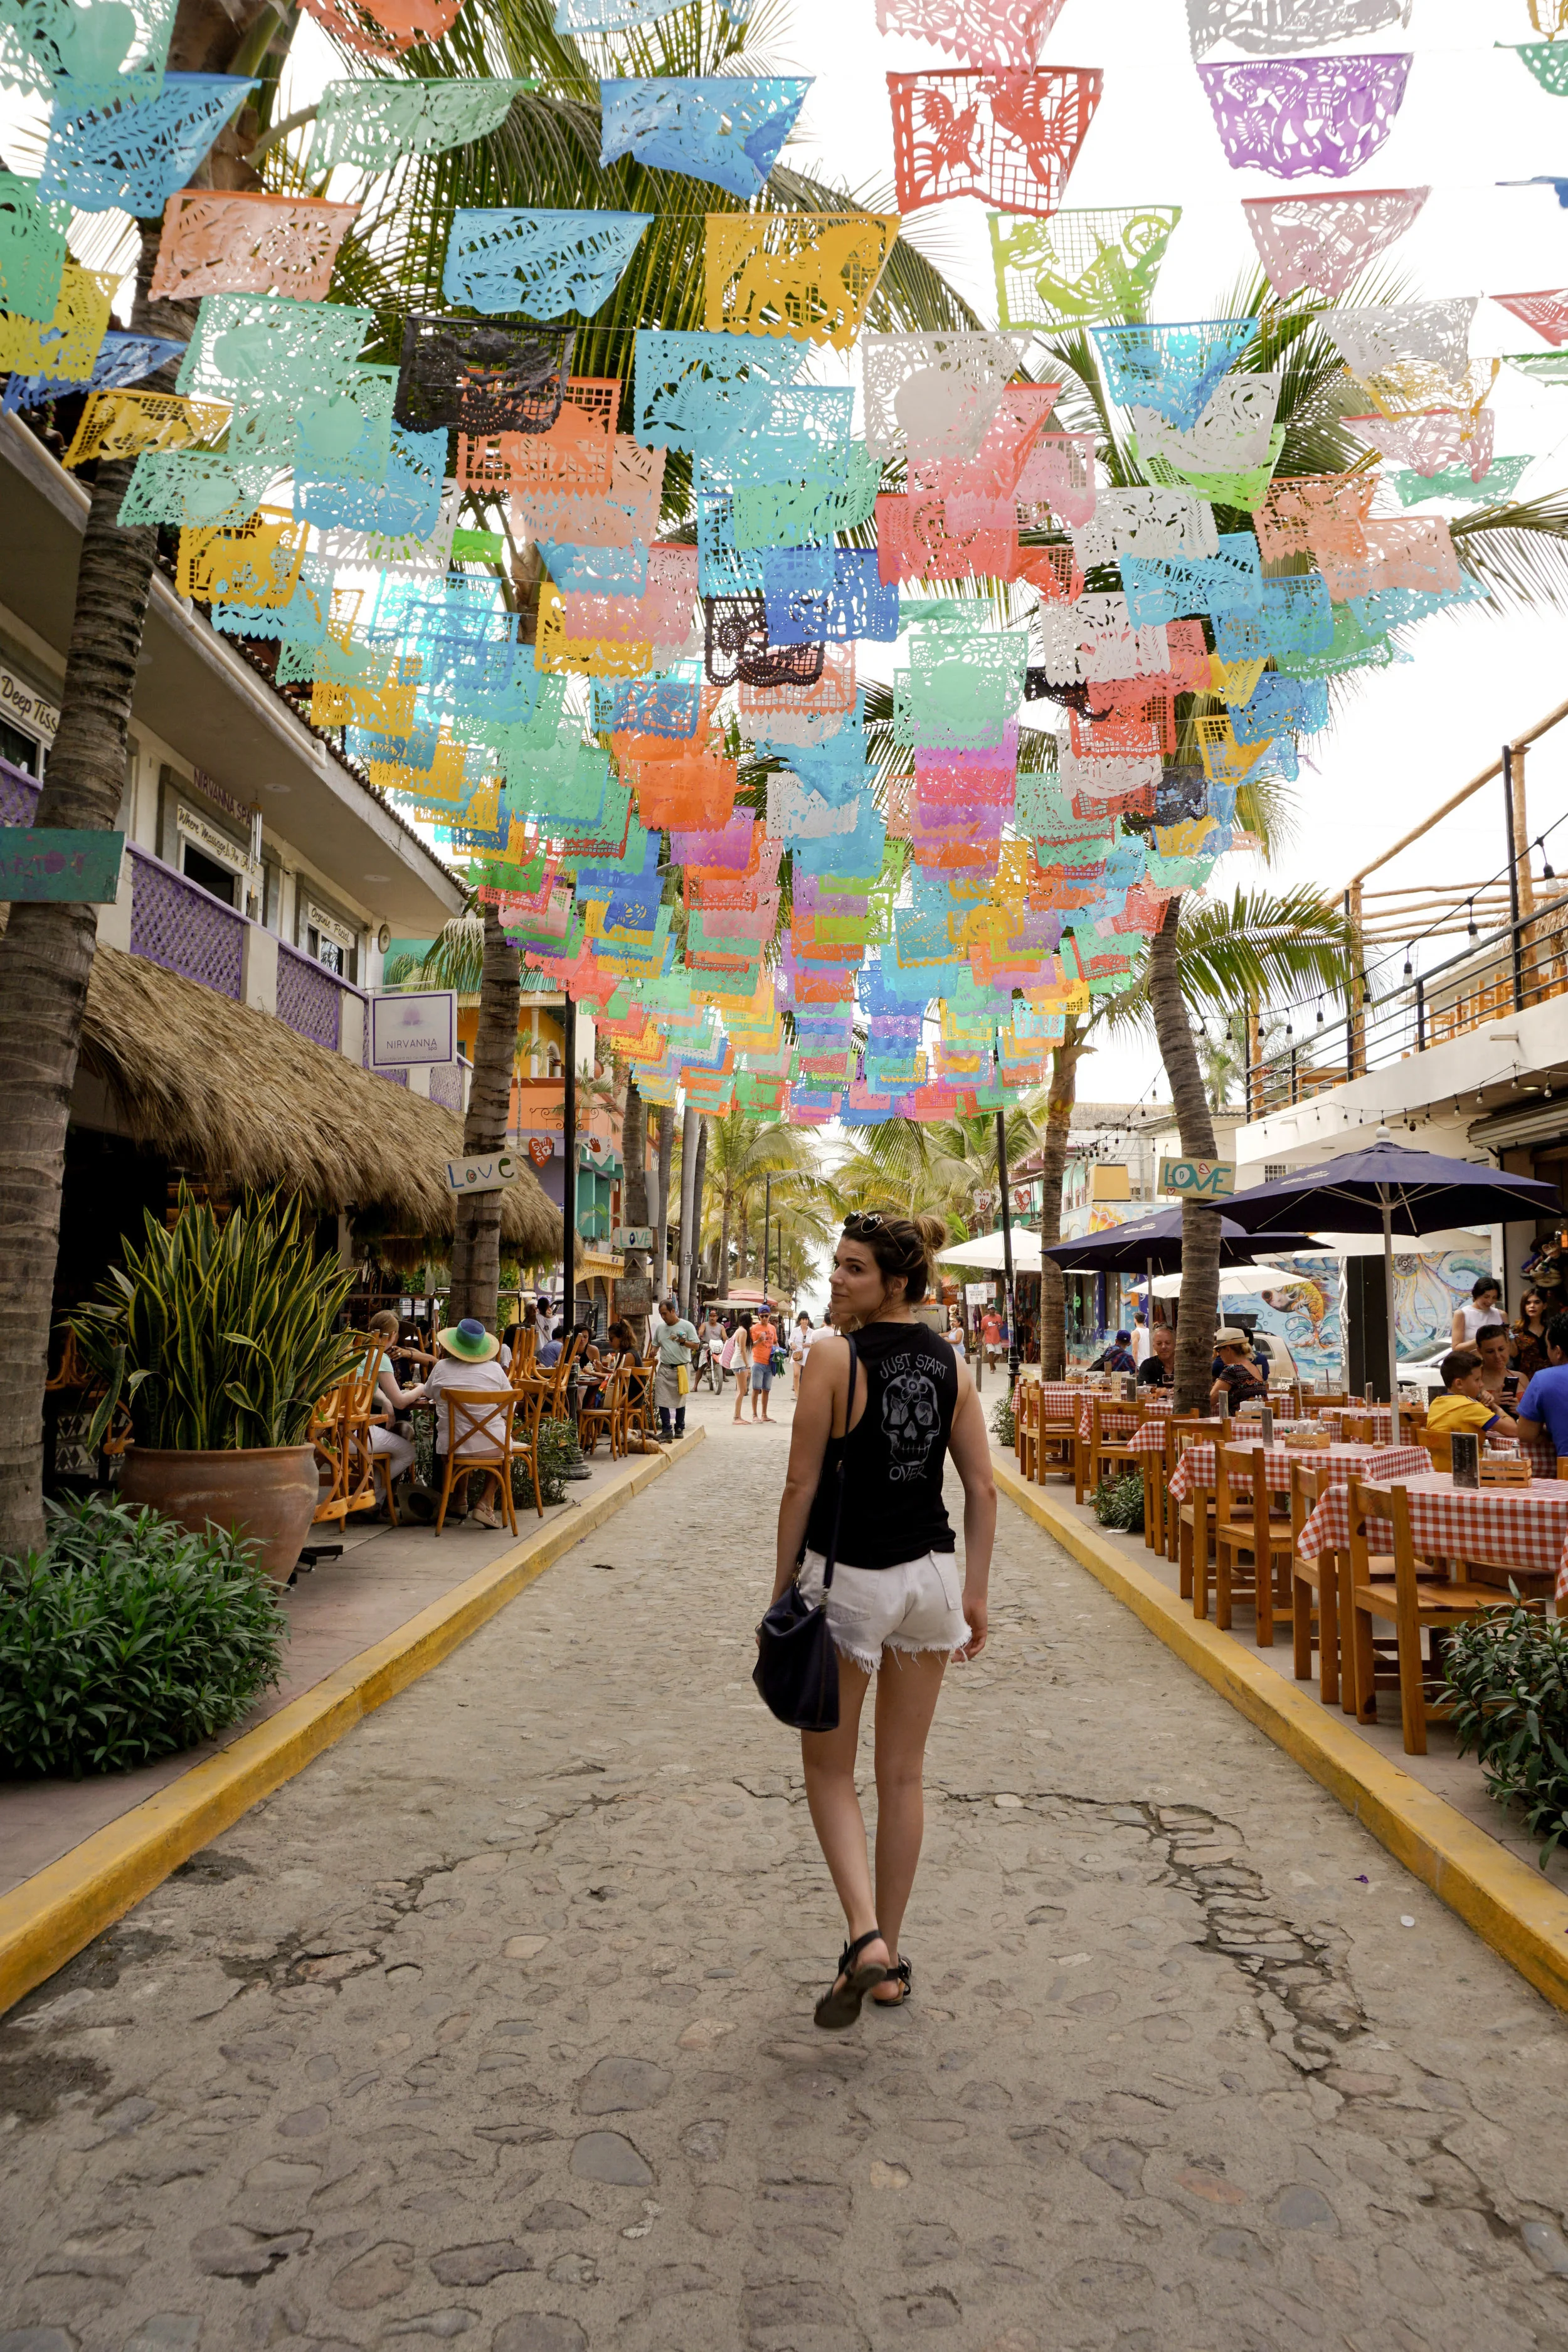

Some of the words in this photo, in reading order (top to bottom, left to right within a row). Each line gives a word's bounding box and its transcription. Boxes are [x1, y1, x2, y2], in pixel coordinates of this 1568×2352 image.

[458, 220, 539, 257] FIESTA
[511, 225, 626, 283] MEXICANA
[2, 675, 32, 716] Deep
[194, 766, 235, 814] NIRVANNA
[178, 808, 199, 834] Where
[201, 823, 226, 855] Massage
[312, 907, 331, 928] Organic
[334, 923, 350, 943] Facial
[386, 1039, 438, 1049] NIRVANNA
[531, 1141, 546, 1162] LOVE
[1164, 1162, 1234, 1195] LOVE
[619, 1229, 652, 1247] LOVE
[880, 1353, 911, 1379] JUST
[915, 1353, 948, 1379] START
[889, 1465, 928, 1482] OVER
